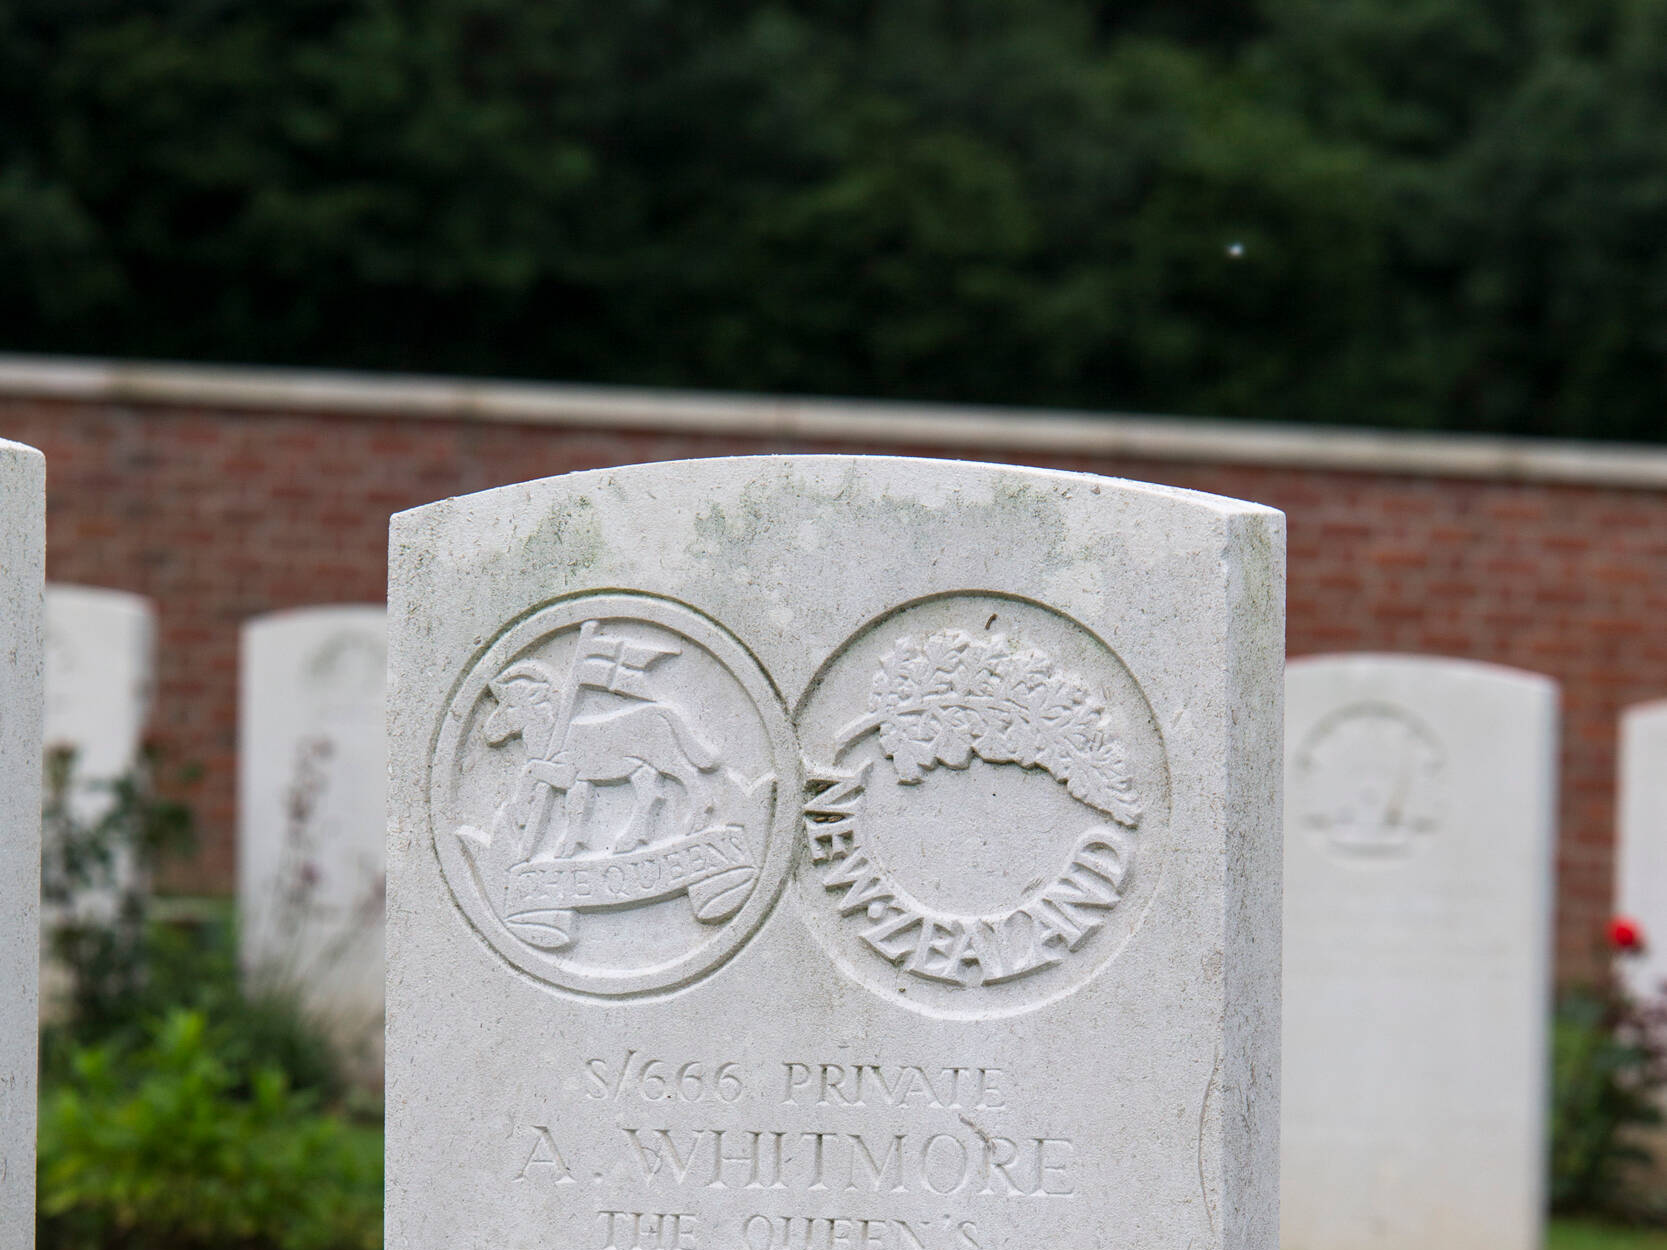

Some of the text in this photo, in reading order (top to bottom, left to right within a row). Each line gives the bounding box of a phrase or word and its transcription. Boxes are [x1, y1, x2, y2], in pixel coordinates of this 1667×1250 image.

[584, 1051, 1007, 1111] S/666 PRIVATE
[623, 1128, 1077, 1199] WHITMORE
